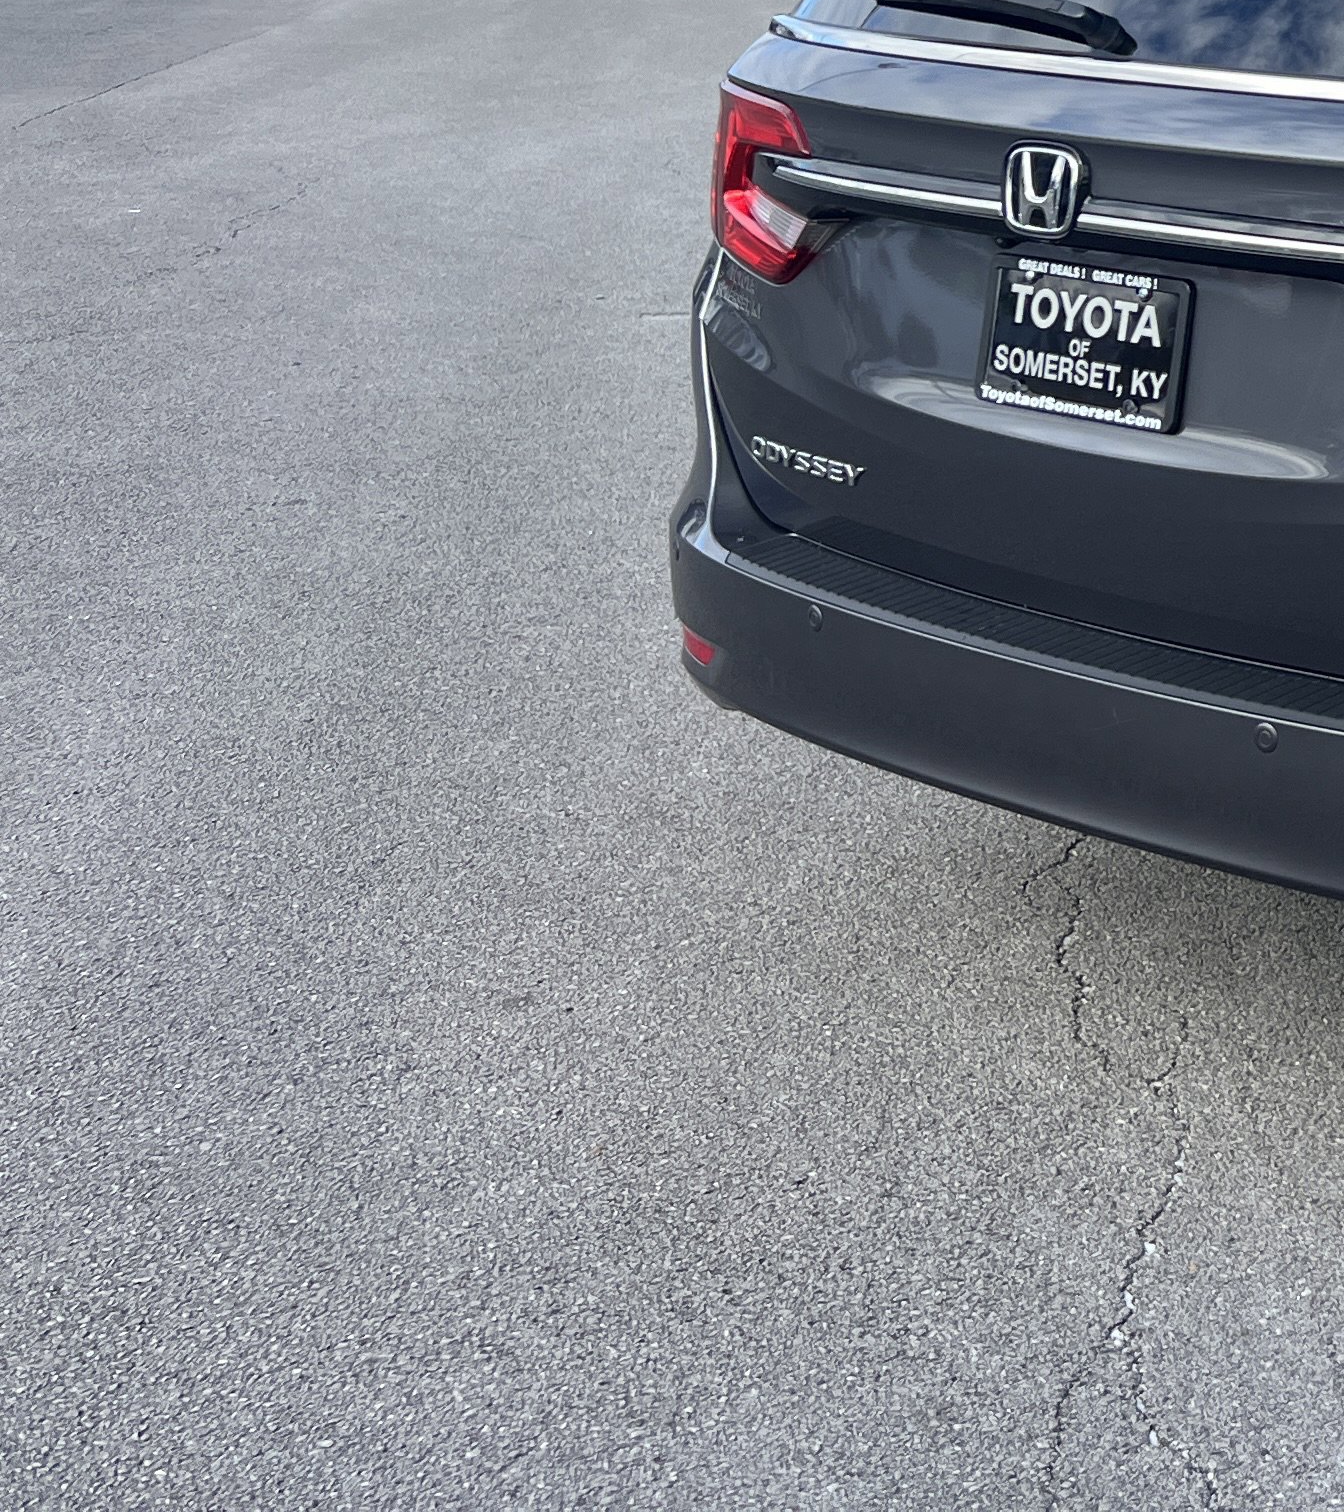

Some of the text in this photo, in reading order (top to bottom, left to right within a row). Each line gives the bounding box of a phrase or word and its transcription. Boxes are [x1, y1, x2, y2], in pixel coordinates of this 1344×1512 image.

[1018, 258, 1049, 274] GREAT
[1092, 269, 1124, 285] GREAT
[1011, 283, 1162, 348] TOYOTA
[993, 344, 1168, 400] SOMERSET, KY
[1068, 338, 1091, 358] OF
[980, 384, 1162, 430] ToyotaofSomerset.com
[752, 435, 865, 486] ODYSSEY
